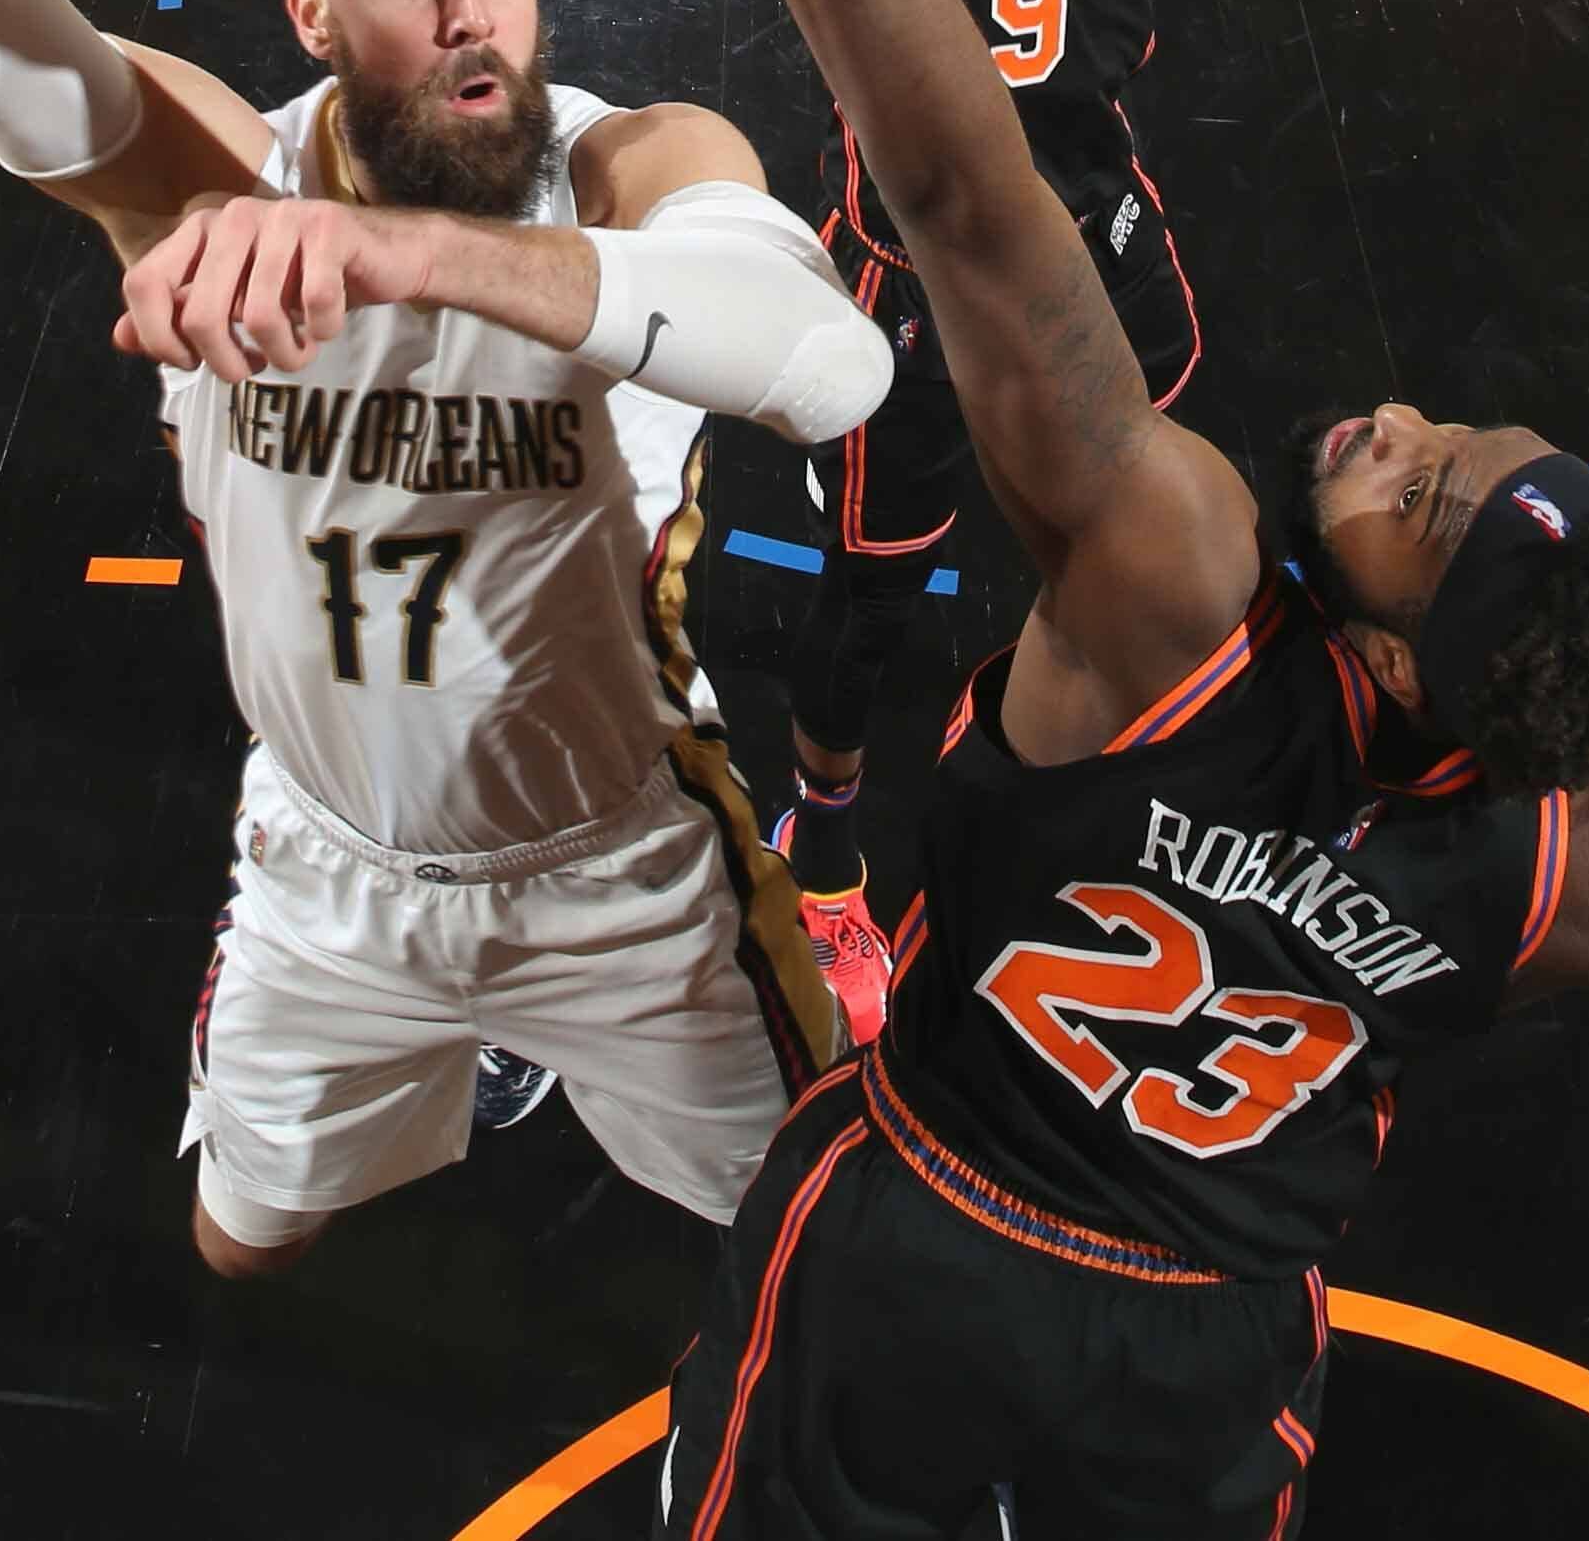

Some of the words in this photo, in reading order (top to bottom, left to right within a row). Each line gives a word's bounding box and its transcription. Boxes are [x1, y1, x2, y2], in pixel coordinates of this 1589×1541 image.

[228, 378, 346, 479] NEW
[347, 387, 587, 497] ORLEANS
[304, 525, 469, 688] 17
[1137, 797, 1460, 997] ROBINSON
[972, 881, 1370, 1160] 23
